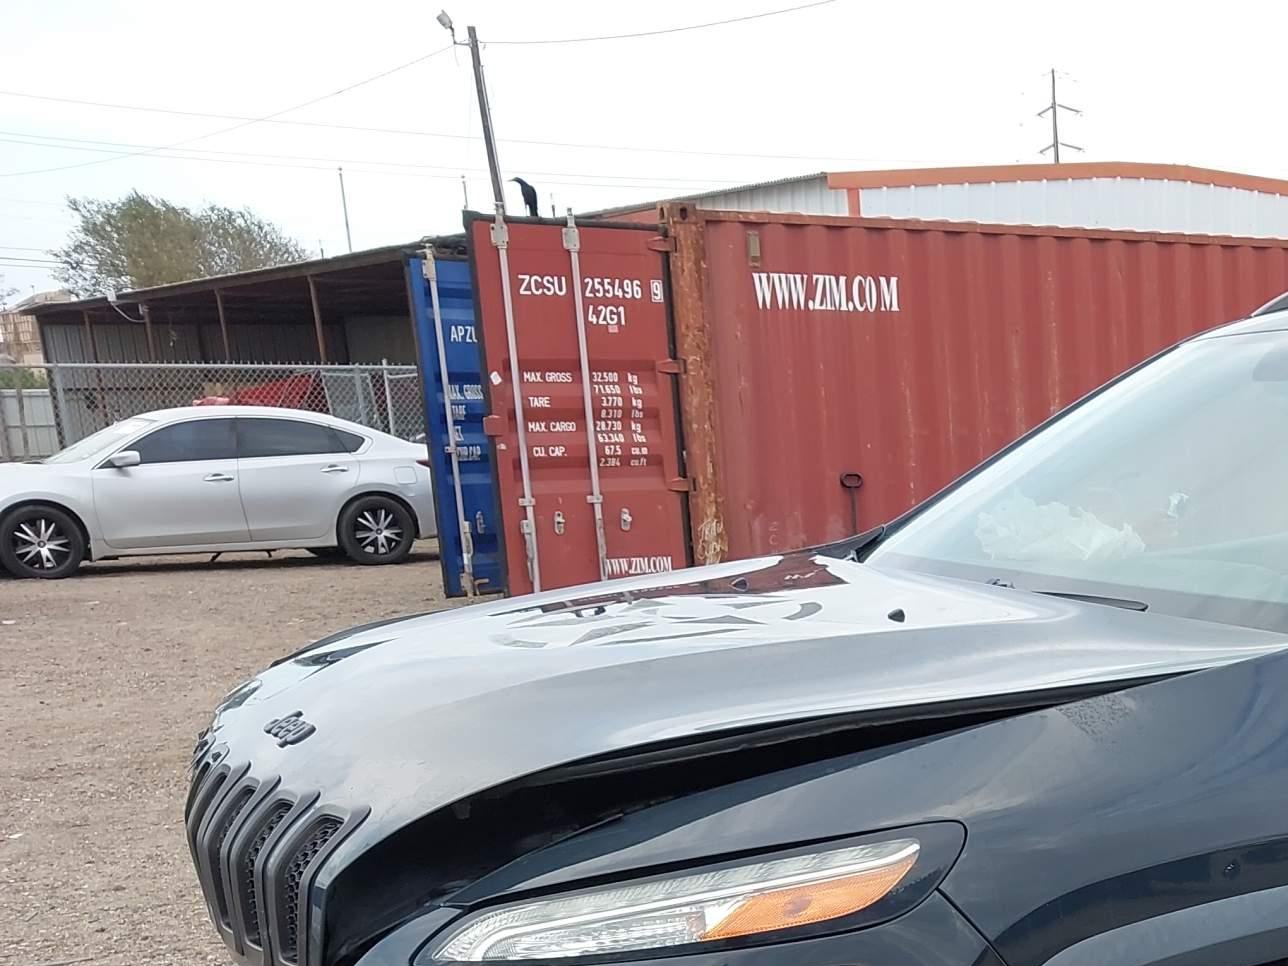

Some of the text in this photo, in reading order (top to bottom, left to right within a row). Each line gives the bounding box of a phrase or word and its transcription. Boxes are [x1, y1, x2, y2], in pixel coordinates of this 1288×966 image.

[517, 274, 567, 296] ZCSU
[583, 277, 642, 299] 255496
[587, 304, 626, 326] 42G1
[523, 371, 638, 385] MAX. GROSS 32.500 kg
[629, 384, 643, 395] lbs
[528, 396, 643, 409] TARE 3.770 kg
[527, 421, 548, 433] MAX.
[549, 421, 577, 433] CARGO
[631, 421, 642, 433] kg
[532, 446, 548, 457] CU.
[548, 446, 568, 457] CAP.
[604, 445, 622, 456] 67.5
